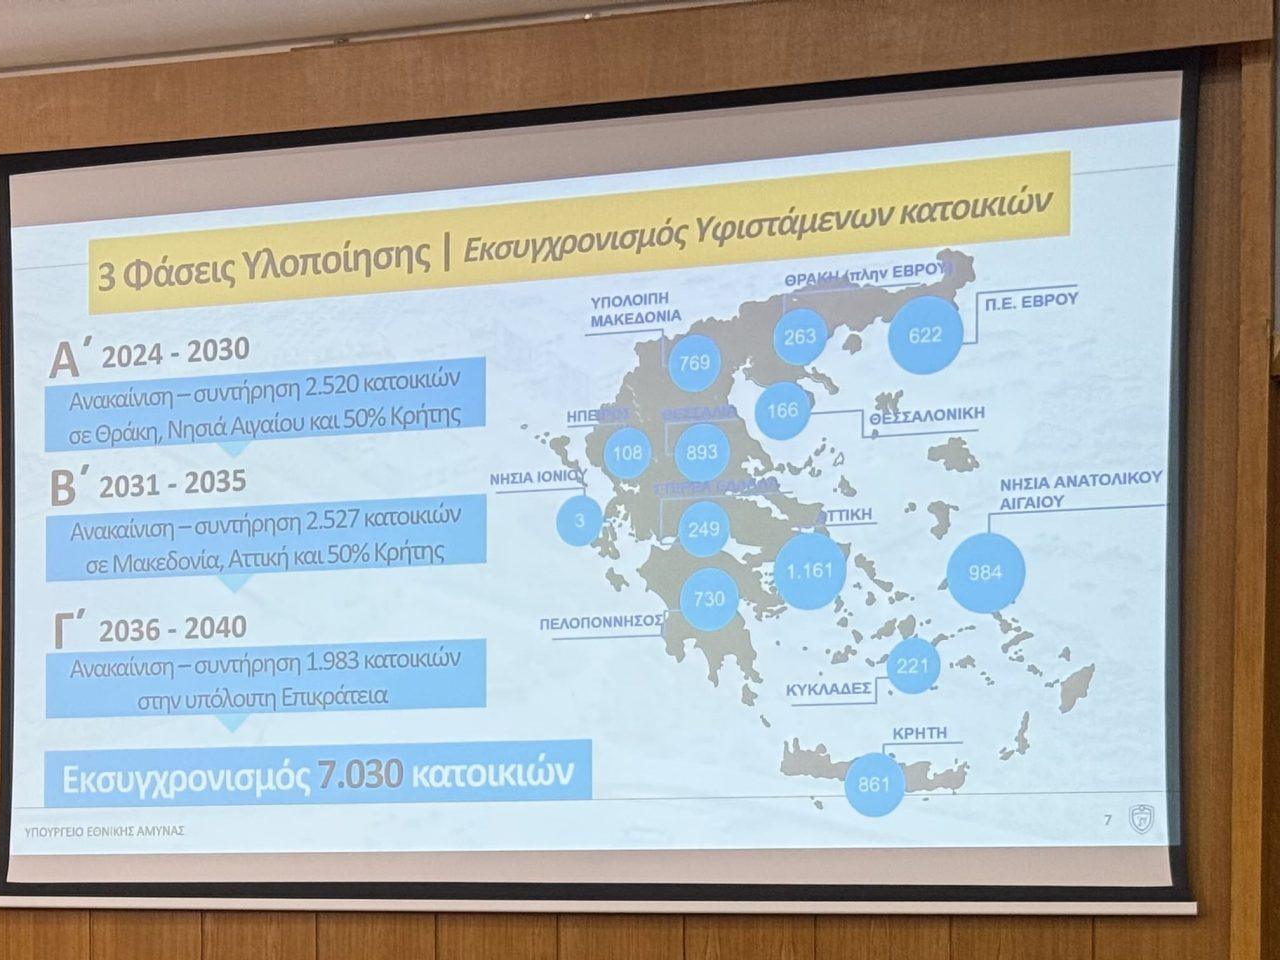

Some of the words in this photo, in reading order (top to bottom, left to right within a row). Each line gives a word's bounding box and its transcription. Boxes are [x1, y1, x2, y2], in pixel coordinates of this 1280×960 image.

[97, 263, 116, 292] 3
[123, 255, 235, 290] Φάσεις
[242, 239, 431, 281] Υλοποίησης
[463, 217, 689, 263] Εκσυγχρονισμός
[696, 206, 894, 247] Υφιστάμενων
[900, 185, 1054, 225] κατοικιών
[590, 291, 669, 310] ΥΠΟΛΟΙΠΗ
[985, 295, 1017, 312] Π.Ε.
[1021, 292, 1079, 309] ΕΒΡΟΥ
[590, 309, 682, 328] ΜΑΚΕΔΟΝΙΑ
[784, 328, 817, 346] 263
[908, 326, 943, 344] 622
[101, 342, 163, 369] 2024
[187, 336, 250, 363] 2030
[679, 355, 711, 373] 769
[69, 387, 174, 414] Ανακαίνιση
[194, 377, 301, 408] συντήρηση
[305, 373, 360, 399] 2.520
[363, 368, 462, 392] κατοικιών
[767, 401, 799, 419] 166
[869, 405, 985, 426] ΘΕΣΣΑΛΟΝΙΚΗ
[68, 427, 93, 446] σε
[95, 419, 163, 450] Θράκη,
[167, 415, 227, 441] Νησιά
[230, 410, 306, 440] Αιγαίου
[309, 409, 341, 432] και
[343, 406, 387, 430] 50%
[390, 402, 462, 433] Κρήτης
[612, 445, 643, 461] 108
[686, 443, 719, 460] 893
[99, 475, 160, 499] 2031
[184, 469, 247, 495] 2035
[490, 471, 535, 486] ΝΗΣΙΑ
[537, 468, 588, 483] ΙΟΝΙΟΥ
[1000, 475, 1051, 492] ΝΗΣΙΑ
[1055, 470, 1163, 489] ΑΝΑΤΟΛΙΚΟΥ
[1000, 494, 1065, 511] ΑΙΓΑΙΟΥ
[70, 518, 175, 546] Ανακαίνιση
[194, 511, 302, 541] συντήρηση
[305, 508, 360, 533] 2.527
[364, 505, 462, 528] κατοικιών
[575, 513, 585, 527] 3
[688, 521, 720, 538] 249
[86, 558, 109, 576] σε
[113, 549, 226, 575] Μακεδονία,
[228, 545, 290, 572] Αττική
[293, 547, 324, 566] και
[327, 543, 371, 565] 50%
[375, 541, 445, 566] Κρήτης
[787, 562, 834, 580] 1.161
[968, 564, 1004, 581] 984
[694, 591, 725, 607] 730
[99, 619, 161, 643] 2036
[184, 614, 247, 640] 2040
[540, 614, 664, 630] ΠΕΛΟΠΟΝΝΗΣΟΣ
[70, 655, 175, 684] Ανακαίνιση
[194, 651, 302, 681] συντήρηση
[306, 649, 360, 673] 1.983
[364, 646, 462, 670] κατοικιών
[896, 657, 929, 675] 221
[786, 681, 872, 698] ΚΥΚΛΑΔΕΣ
[137, 695, 181, 715] στην
[281, 685, 389, 711] Επικράτεια
[892, 726, 948, 741] ΚΡΗΤΗ
[62, 759, 311, 799] Εκσυγχρονισμός
[318, 757, 404, 790] 7.030
[412, 753, 575, 788] κατοικιών
[858, 776, 891, 793] 861
[1104, 814, 1113, 826] 7
[25, 826, 84, 838] ΥΠΟΥΡΓΕΙΟ
[87, 826, 135, 837] ΕΘΝΙΚΗΣ
[136, 825, 185, 836] ΑΜΥΝΑΣ
